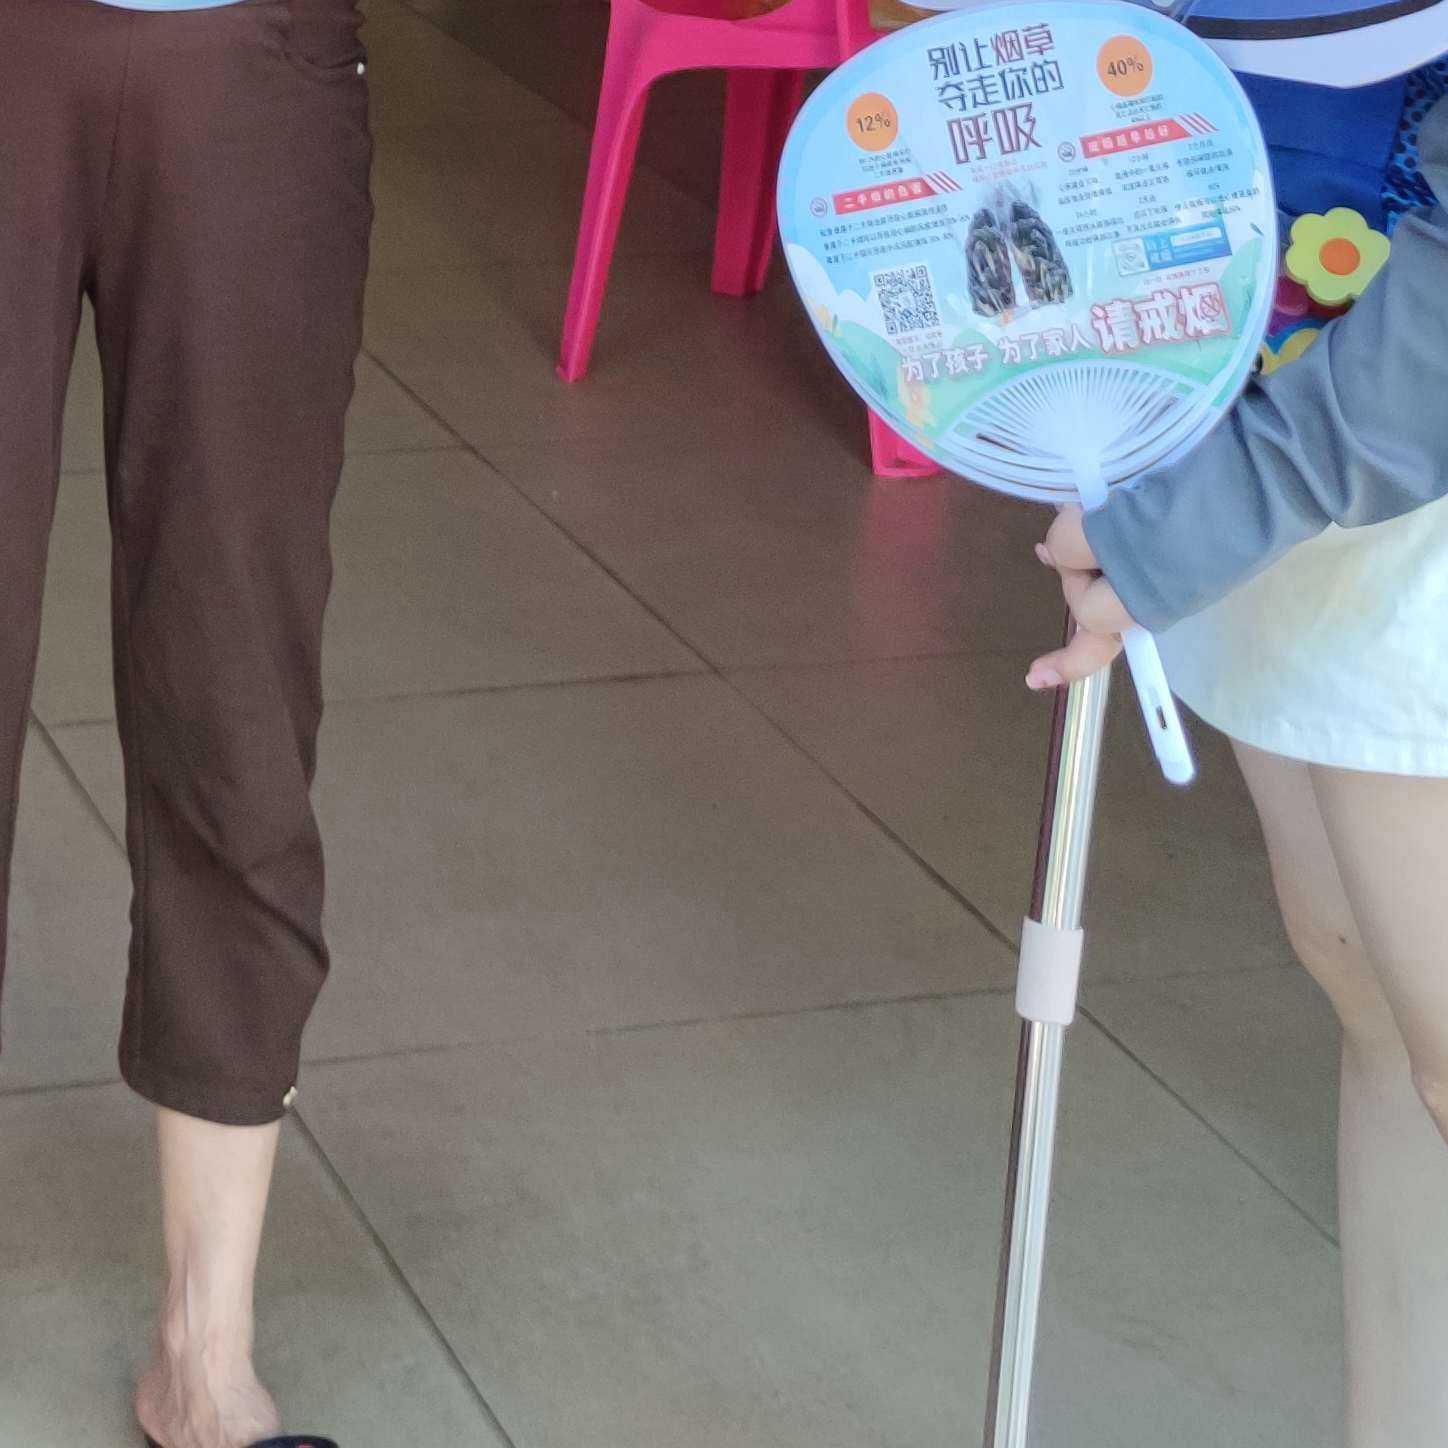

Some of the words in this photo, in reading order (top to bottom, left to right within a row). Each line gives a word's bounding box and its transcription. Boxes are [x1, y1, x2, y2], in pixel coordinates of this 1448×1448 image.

[926, 22, 1055, 81] 别让烟草
[1106, 55, 1145, 77] 40%
[936, 58, 1064, 111] 夺走你的
[855, 111, 891, 133] 12%
[946, 101, 1043, 165] 呼吸
[900, 343, 989, 383] 为了孩子
[1000, 323, 1091, 365] 为了家人
[1089, 281, 1233, 355] 请戒烟
